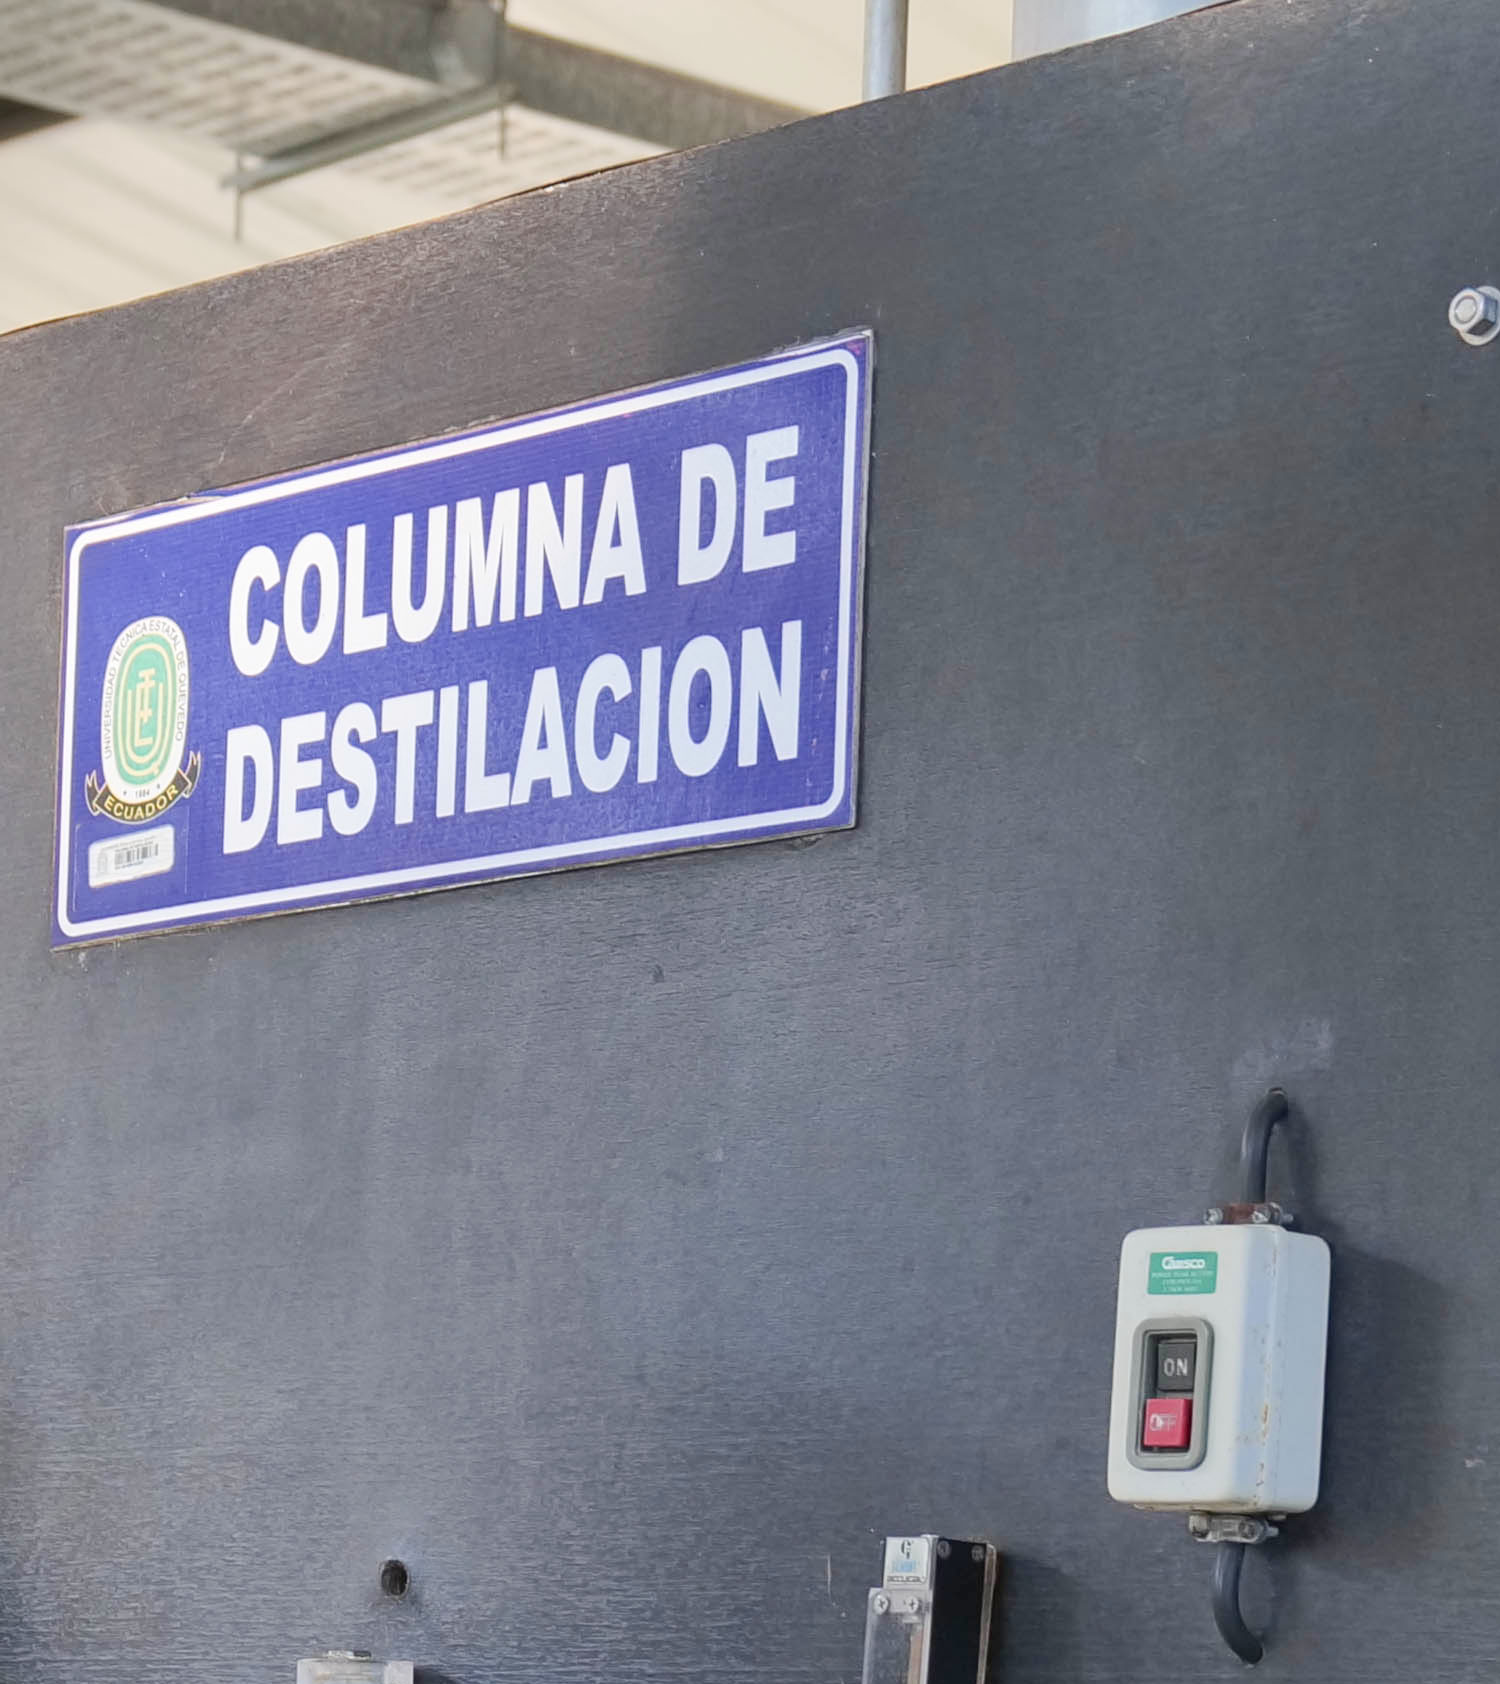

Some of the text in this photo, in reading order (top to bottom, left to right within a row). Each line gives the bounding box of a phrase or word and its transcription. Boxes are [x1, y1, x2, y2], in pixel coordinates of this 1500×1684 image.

[228, 424, 799, 678] COLUMNA DE
[113, 624, 147, 662] TECNICA
[149, 619, 180, 648] ESTATAL
[175, 650, 185, 671] DE
[175, 673, 188, 742] QUEVEDO
[222, 619, 803, 856] DESTILACION
[103, 784, 179, 821] ECUADOR
[1164, 1358, 1188, 1377] ON
